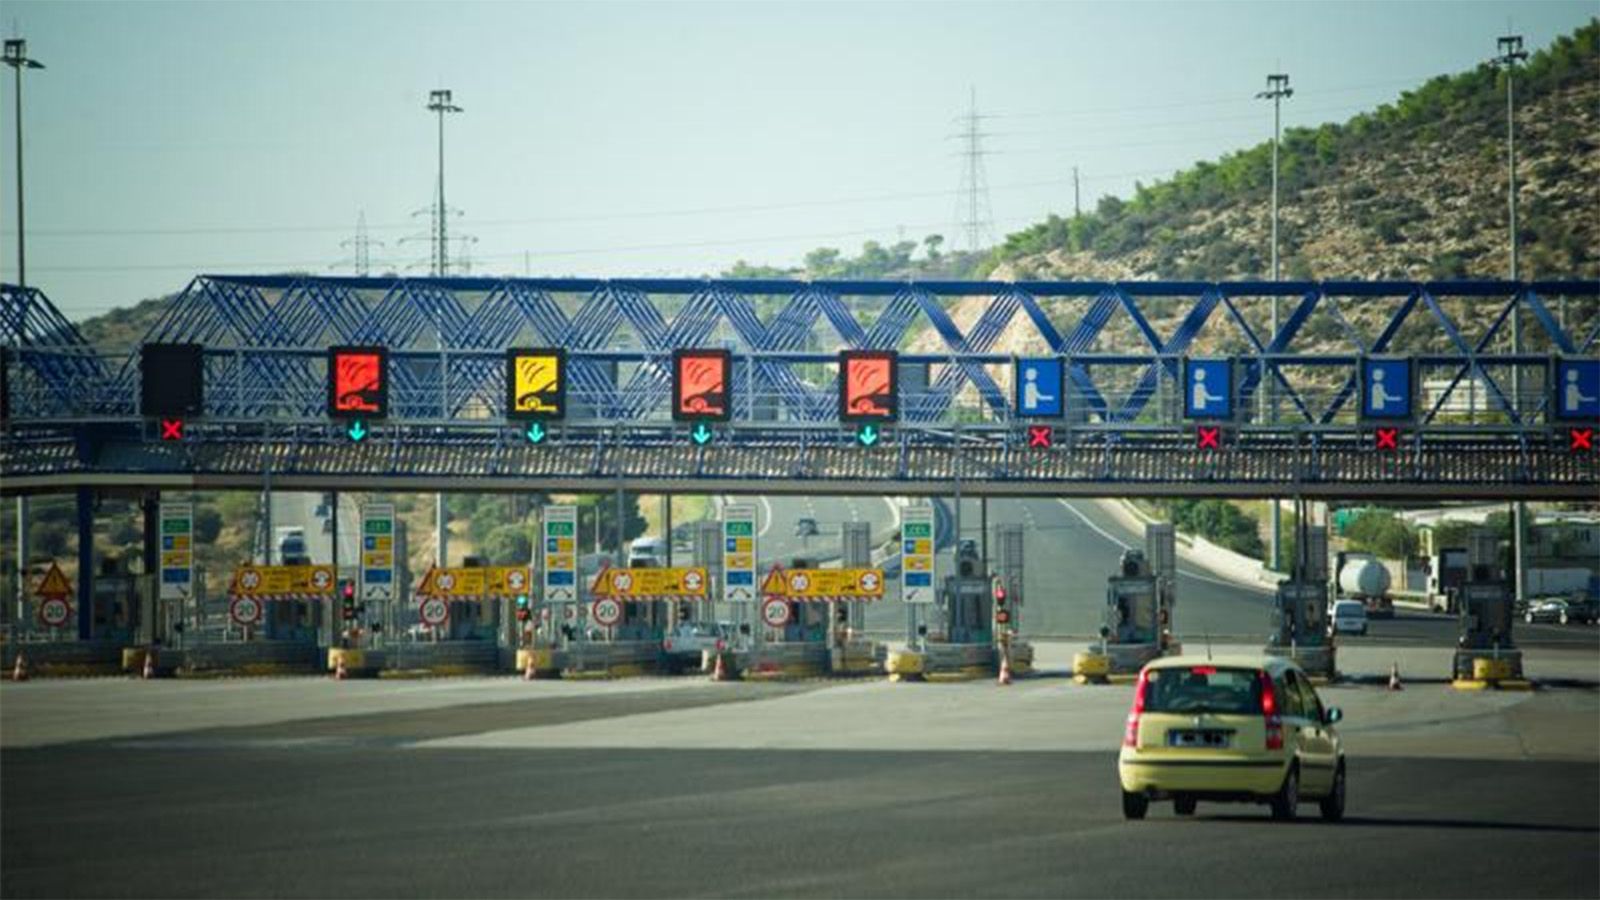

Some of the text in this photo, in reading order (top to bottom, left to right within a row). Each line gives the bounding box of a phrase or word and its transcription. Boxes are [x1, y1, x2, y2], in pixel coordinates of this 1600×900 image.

[427, 603, 443, 617] 20
[600, 604, 616, 618] 20
[769, 605, 786, 619] 20
